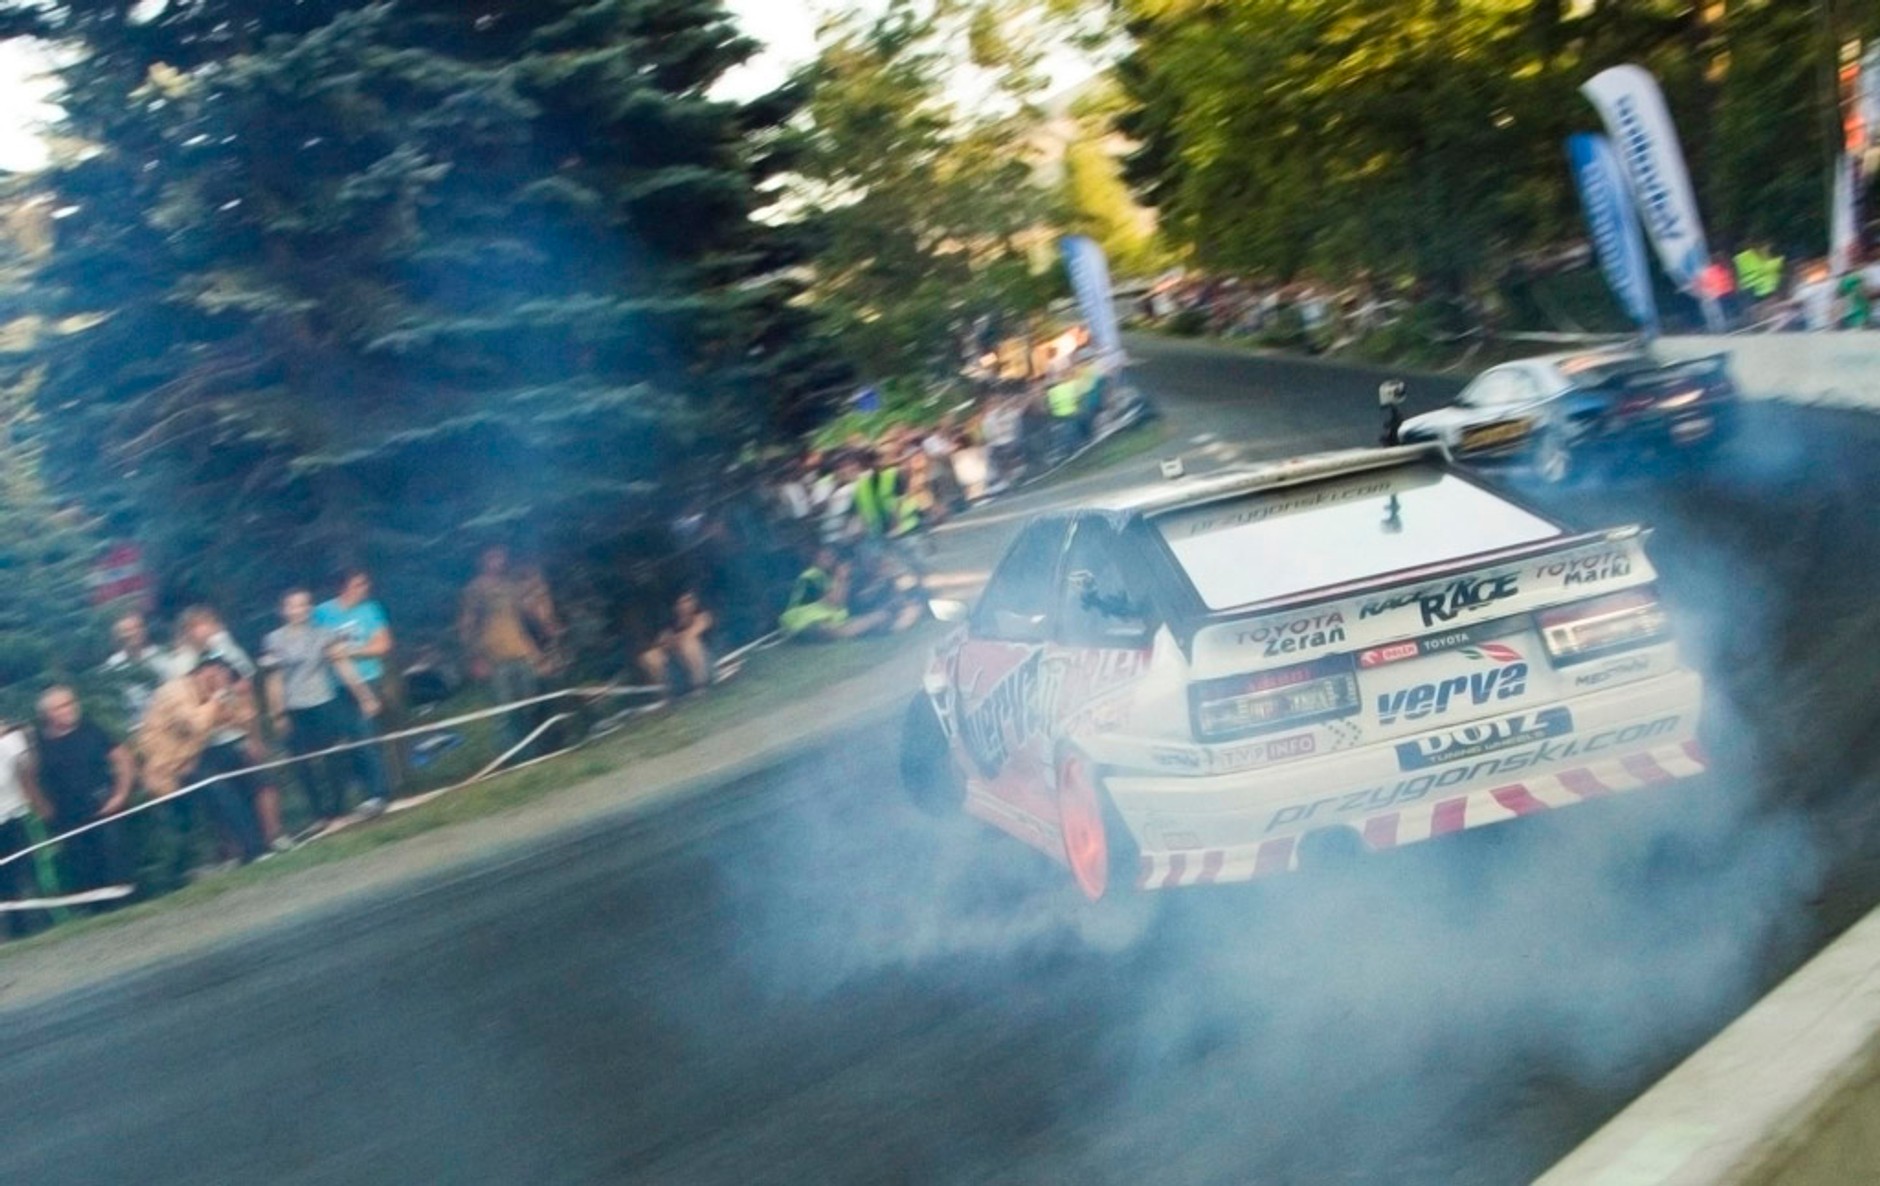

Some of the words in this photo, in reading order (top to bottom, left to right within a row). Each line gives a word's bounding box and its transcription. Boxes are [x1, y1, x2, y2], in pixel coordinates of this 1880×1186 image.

[1536, 551, 1630, 579] TOYOTA
[1420, 569, 1523, 628] RACE
[1236, 612, 1344, 645] TOYOTA
[1423, 633, 1470, 650] TOYOTA
[1377, 662, 1528, 725] verva
[1268, 735, 1313, 760] INFO
[1264, 714, 1682, 833] przygonski.com
